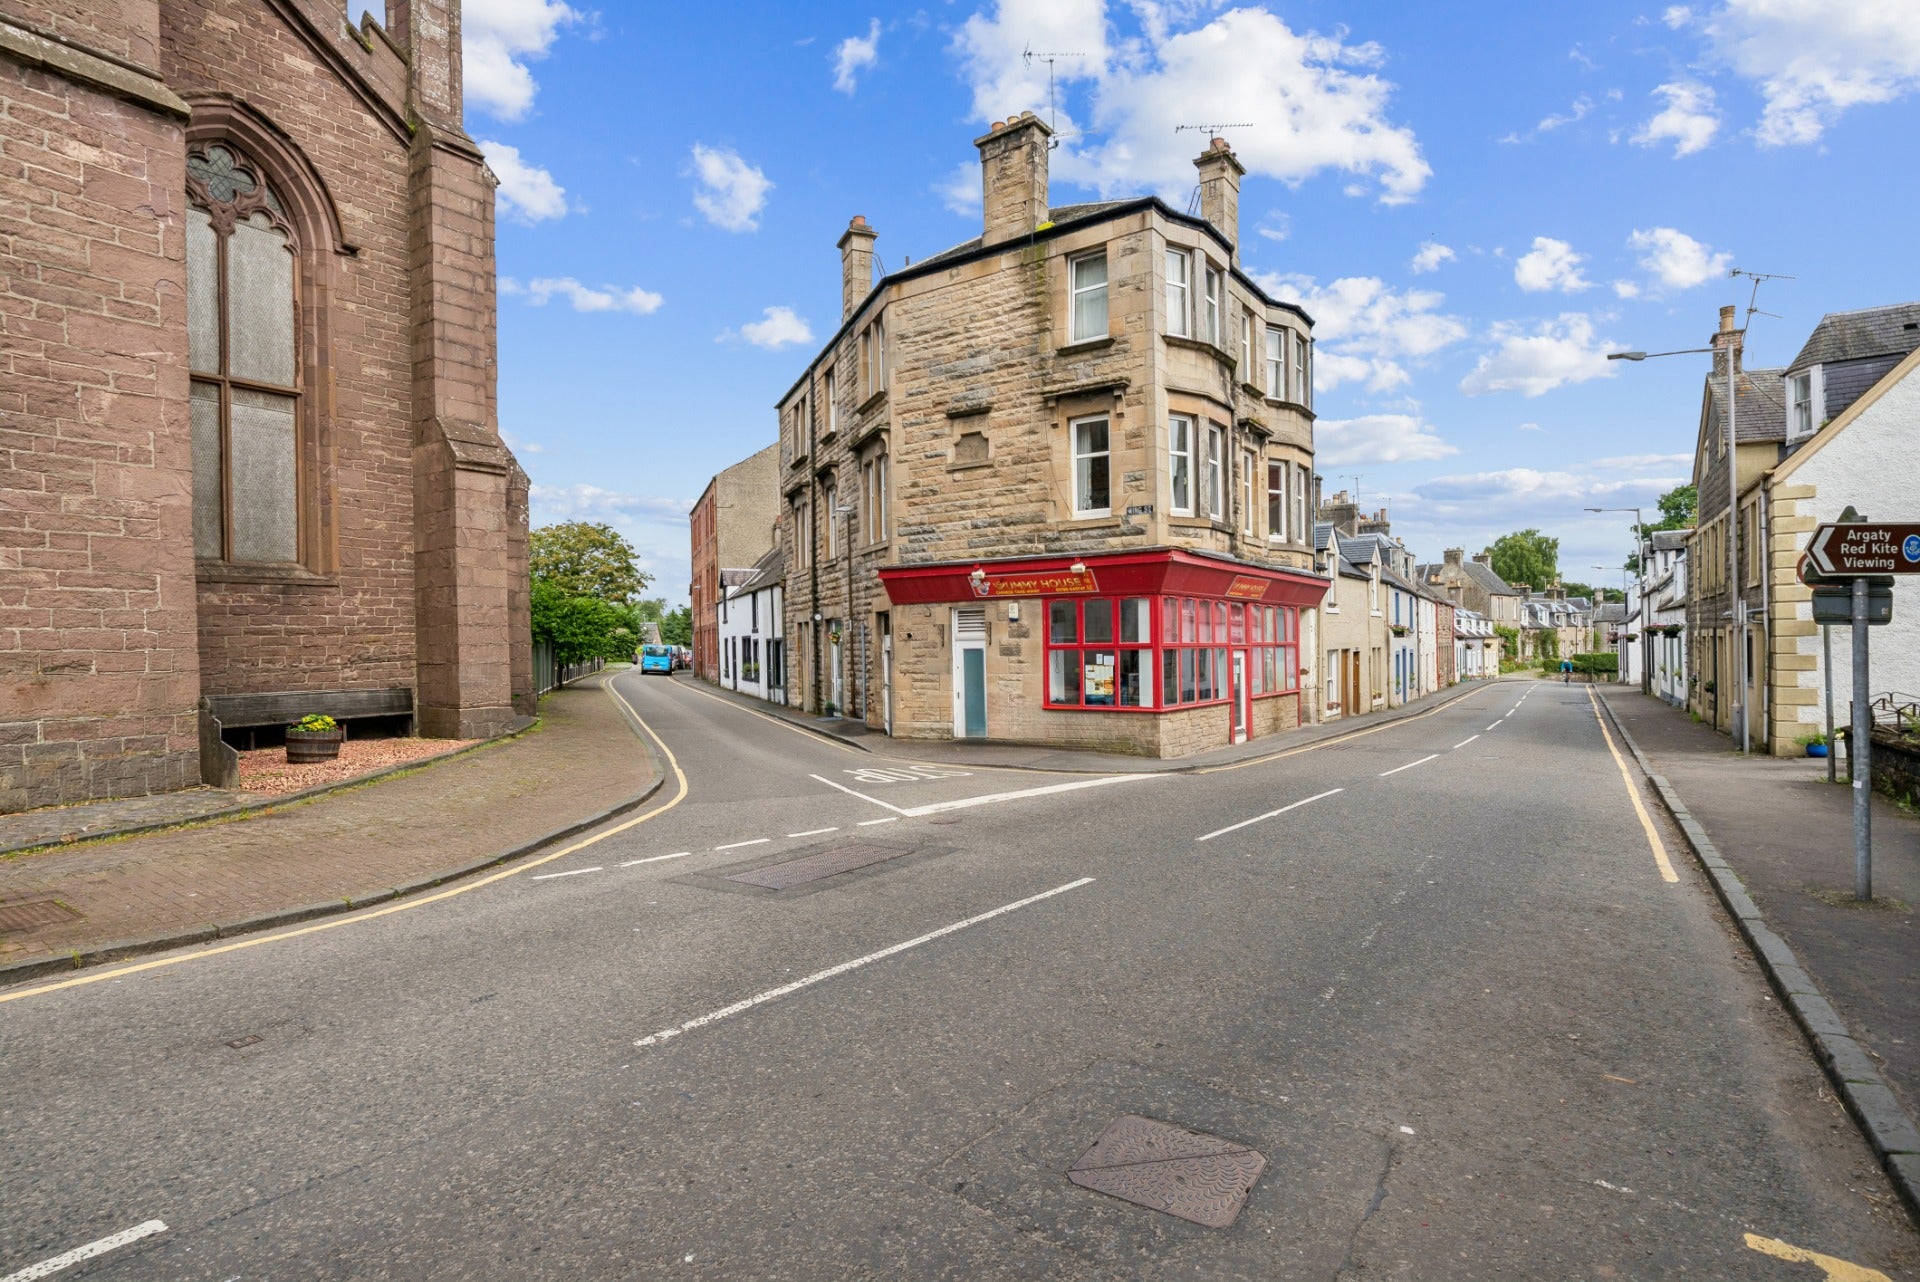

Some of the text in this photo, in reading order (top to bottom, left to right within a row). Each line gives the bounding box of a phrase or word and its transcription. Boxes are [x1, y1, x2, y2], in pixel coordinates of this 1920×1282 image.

[1847, 529, 1891, 543] Argaty
[1840, 543, 1899, 554] Red Kite
[1843, 557, 1895, 569] Viewing
[1040, 577, 1082, 588] HOUSE
